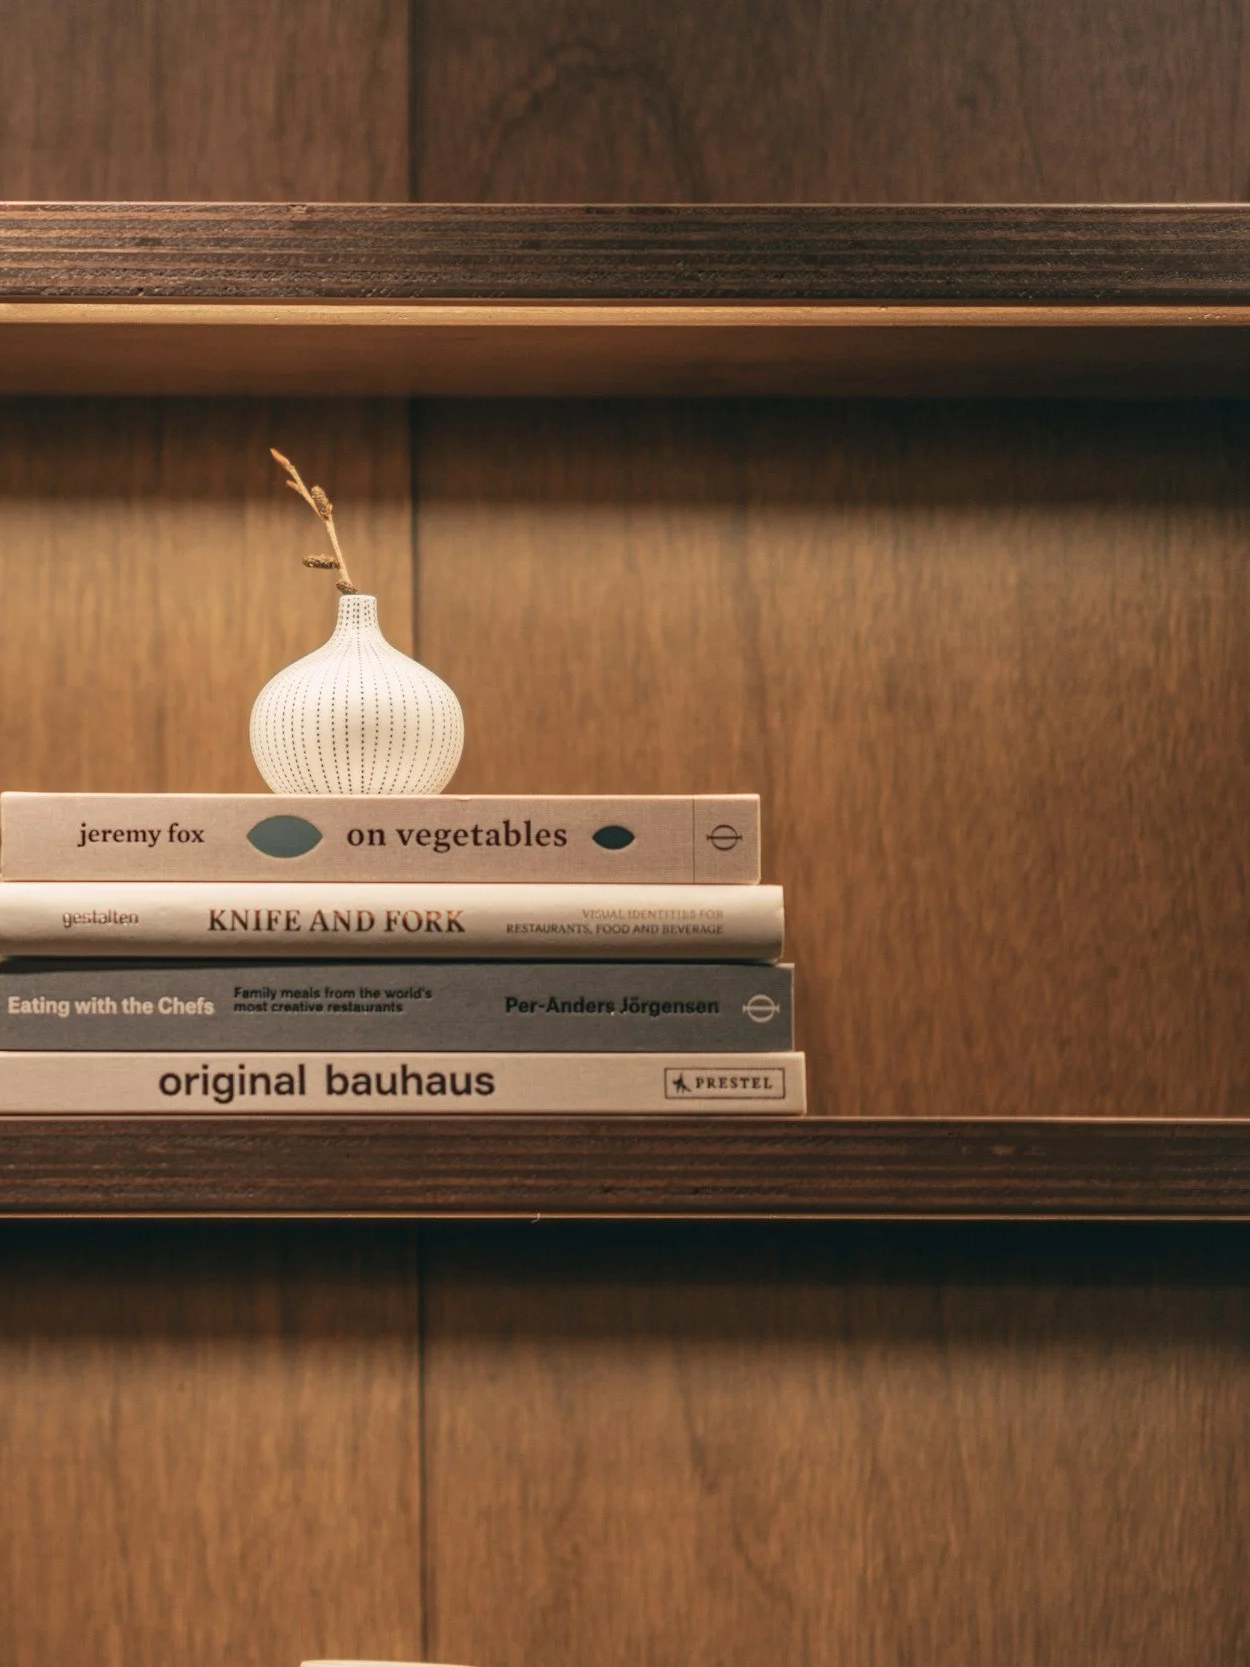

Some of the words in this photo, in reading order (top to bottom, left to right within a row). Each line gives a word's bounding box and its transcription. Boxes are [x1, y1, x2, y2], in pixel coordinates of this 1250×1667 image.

[77, 823, 161, 848] jeremy
[167, 823, 205, 844] fox
[346, 826, 387, 848] on
[396, 820, 568, 853] vegetables
[62, 909, 139, 928] gestalten
[208, 909, 301, 932] KNIFE
[309, 909, 375, 932] AND
[383, 910, 465, 933] FORK
[582, 909, 624, 920] VISUAL
[627, 909, 696, 920] IDENTITIES
[699, 909, 724, 920] FOR
[506, 923, 593, 936] RESTAURANTS,
[595, 923, 630, 935] FOOD
[633, 923, 659, 935] AND
[662, 923, 724, 935] BEVERAGE
[234, 986, 277, 1000] Family
[281, 987, 321, 999] meals
[324, 987, 355, 999] from
[359, 987, 381, 999] the
[383, 986, 432, 999] world's
[8, 996, 70, 1017] Eating
[74, 996, 117, 1014] with
[121, 996, 154, 1015] the
[157, 996, 215, 1016] Chefs
[234, 1001, 268, 1013] most
[271, 1001, 324, 1013] creative
[327, 1001, 403, 1013] restaurants
[505, 997, 615, 1014] Per-Anders
[619, 997, 720, 1017] Jörgensen
[159, 1064, 306, 1104] original
[326, 1064, 495, 1096] bauhaus
[695, 1077, 773, 1090] PRESTEL
